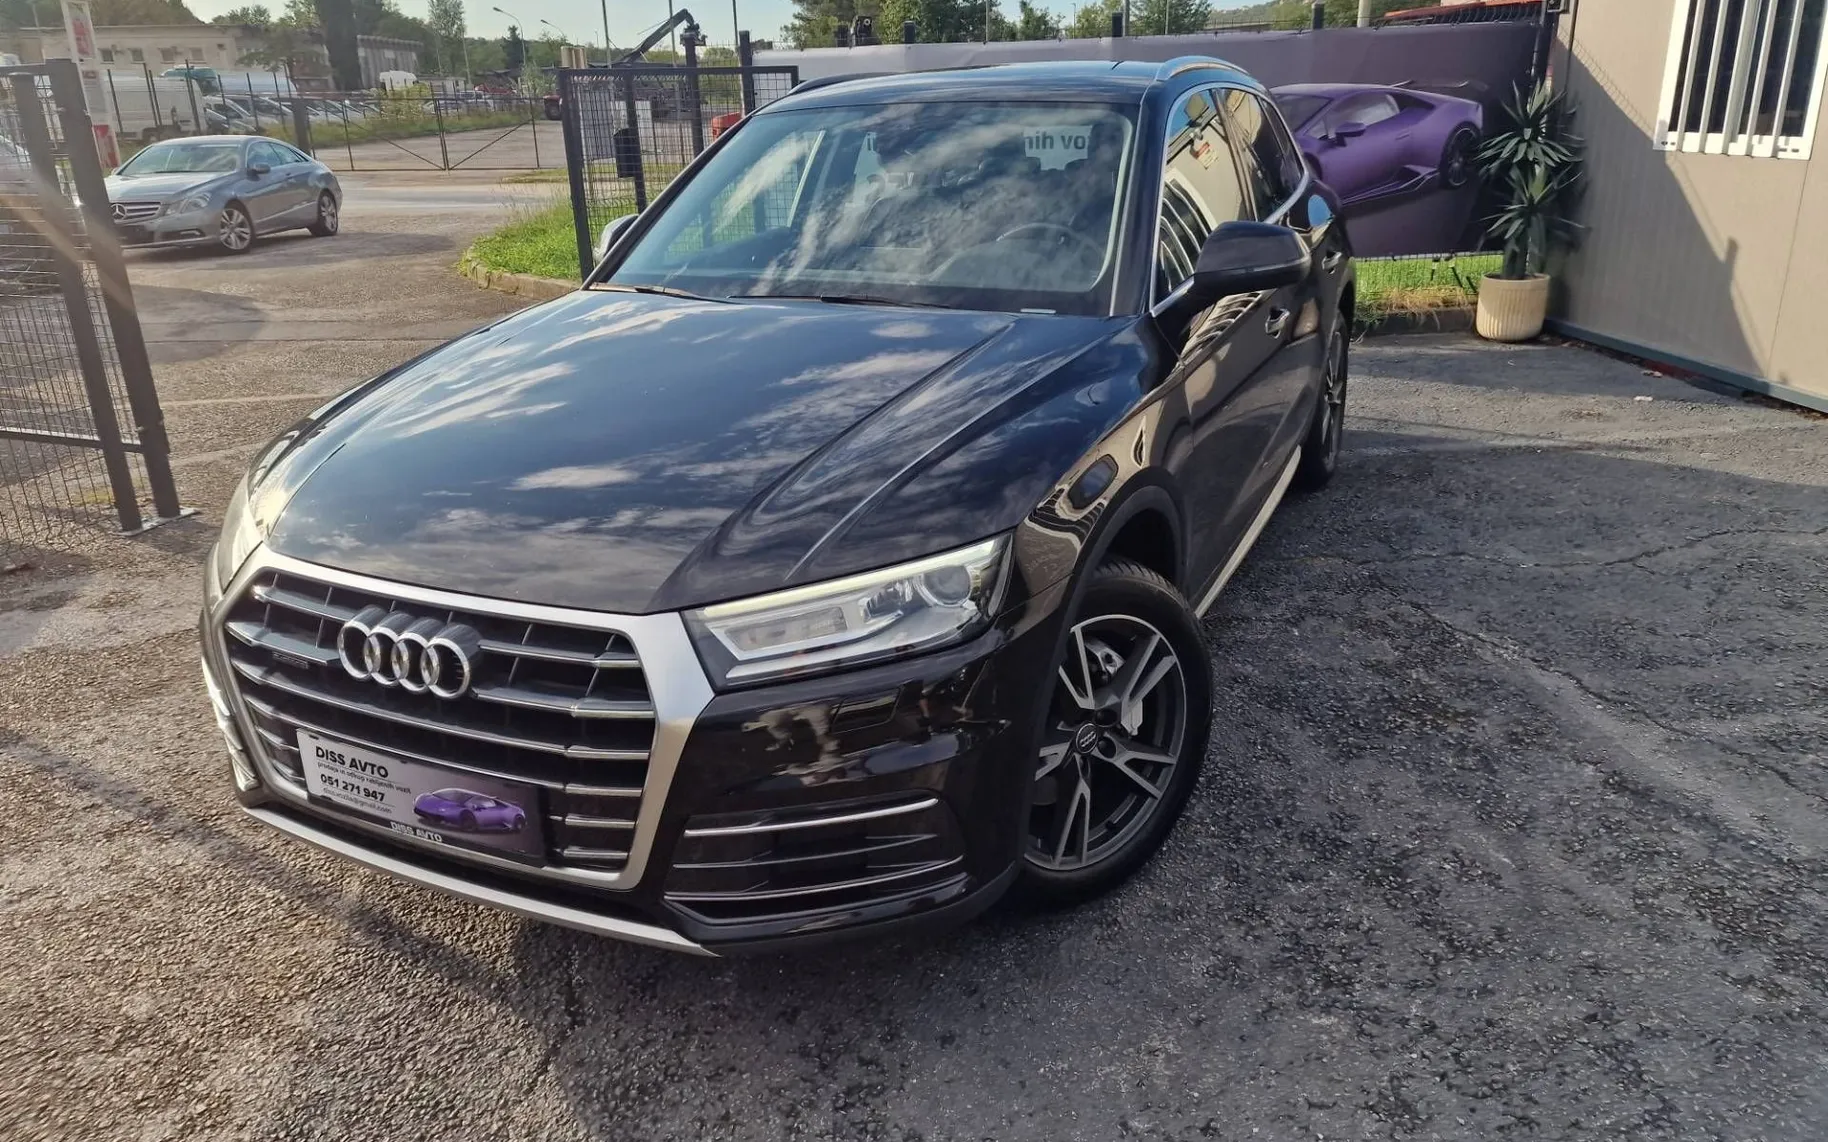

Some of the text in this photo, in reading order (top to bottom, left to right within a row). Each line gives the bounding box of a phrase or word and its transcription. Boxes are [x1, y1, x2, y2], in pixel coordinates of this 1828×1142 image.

[1061, 135, 1091, 150] vo
[316, 746, 389, 778] DISS AVTO
[320, 774, 385, 802] 051 271 947
[390, 821, 443, 842] DISS AVTO
